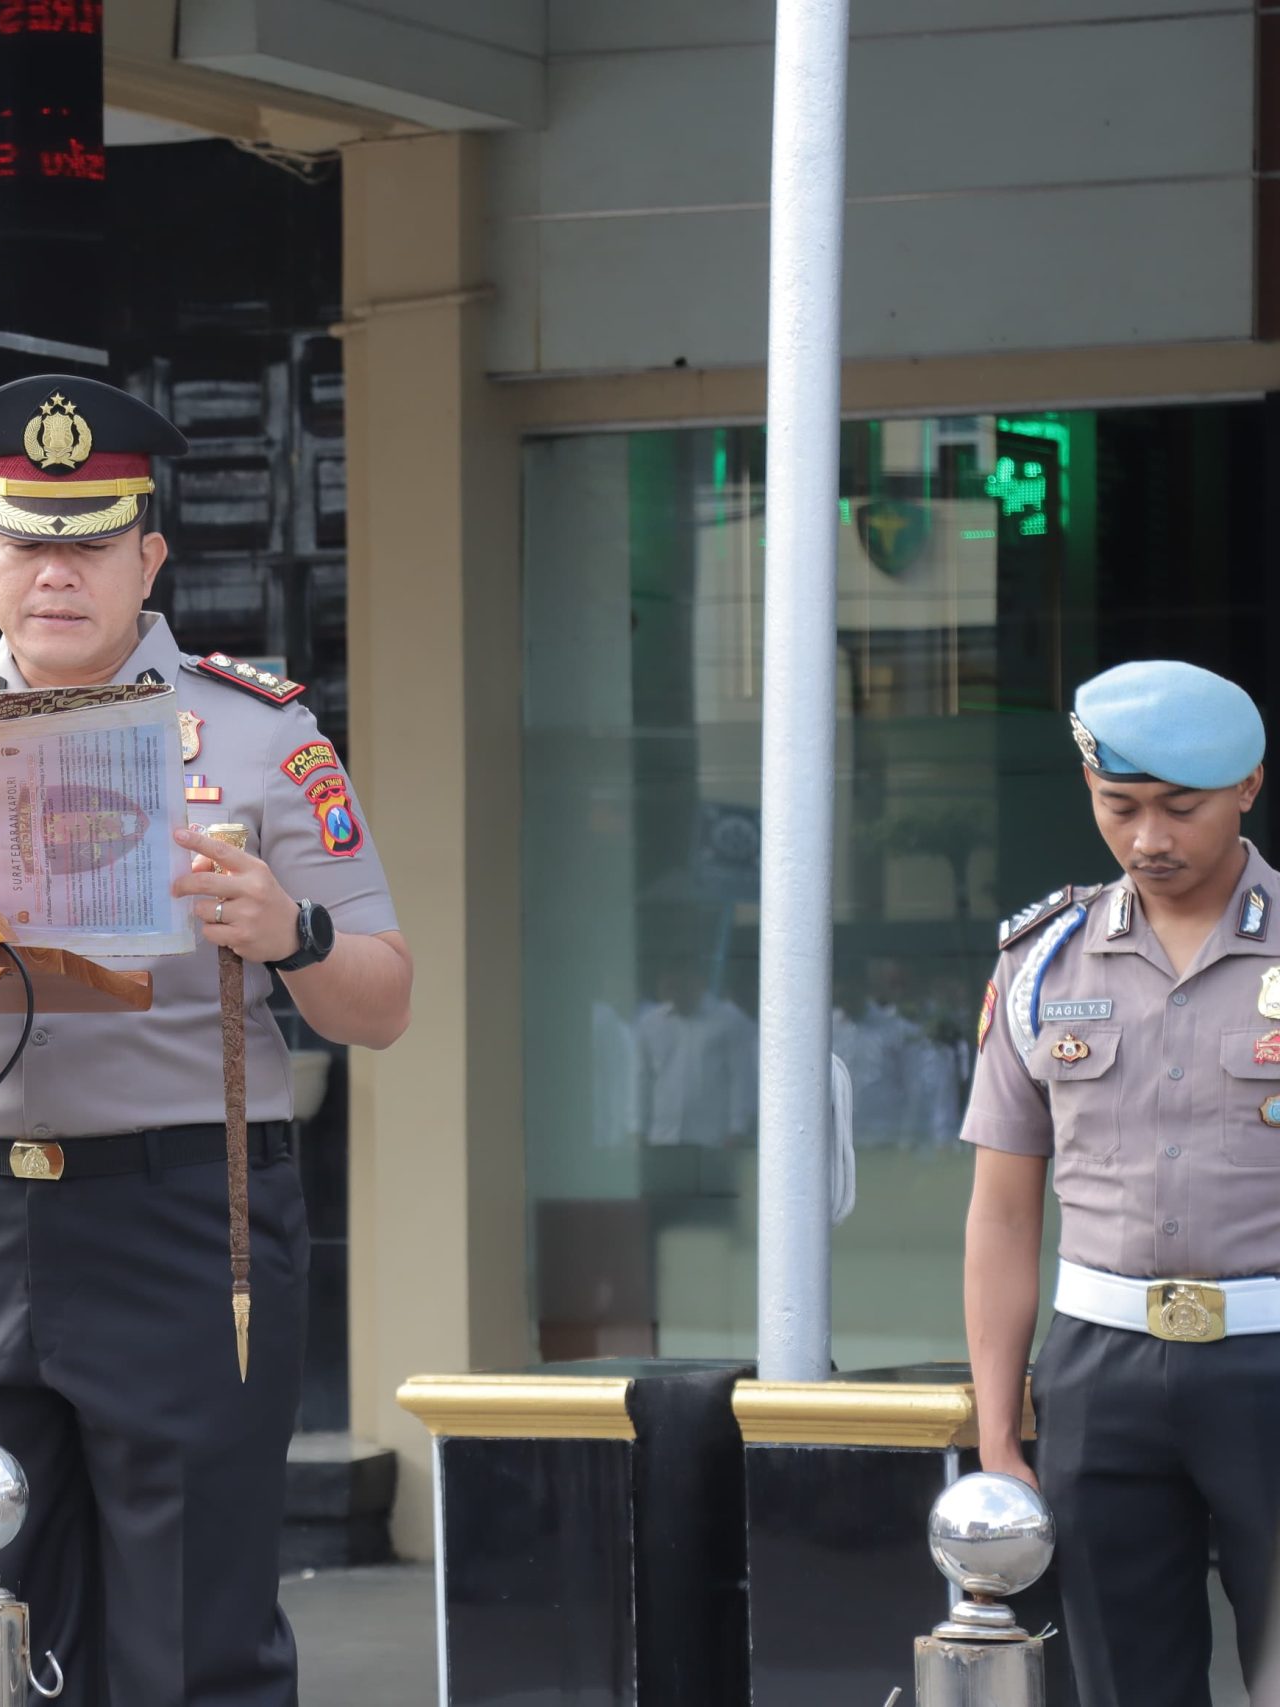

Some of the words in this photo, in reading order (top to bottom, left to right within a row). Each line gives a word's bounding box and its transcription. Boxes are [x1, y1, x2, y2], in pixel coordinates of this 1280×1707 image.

[287, 745, 331, 773] POLRES
[295, 756, 334, 779] LAMONGAN
[311, 783, 326, 798] JAWA
[325, 778, 342, 787] TIMUR
[1047, 1005, 1084, 1017] RAGIL
